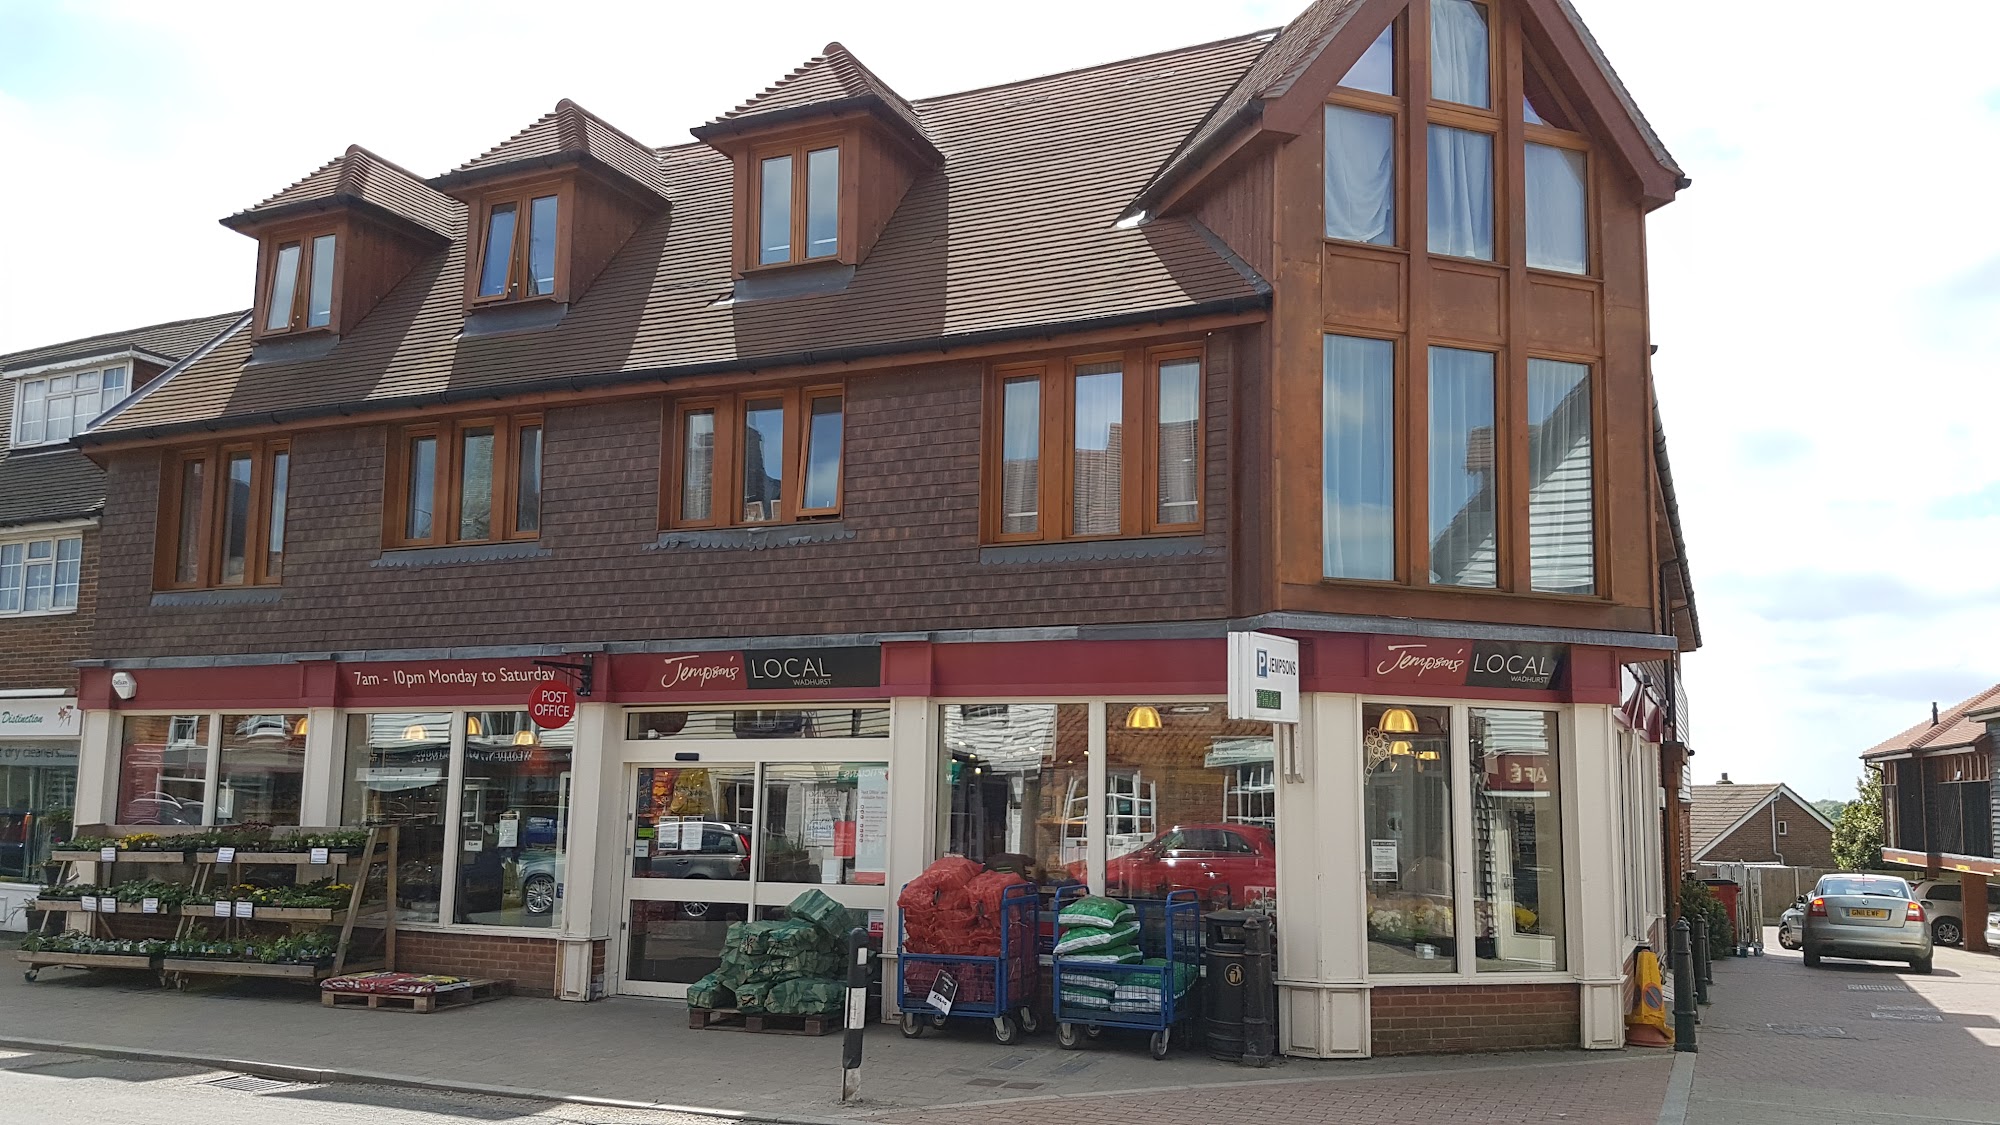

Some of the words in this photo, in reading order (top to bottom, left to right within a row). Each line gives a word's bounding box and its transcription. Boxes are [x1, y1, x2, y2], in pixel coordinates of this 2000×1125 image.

[751, 657, 832, 679] LOCAL
[1268, 657, 1296, 676] JEMPSONS
[1473, 653, 1549, 676] LOCAL
[353, 671, 380, 686] 7am
[393, 670, 426, 688] 10pm
[428, 668, 477, 687] Monday
[481, 671, 496, 683] to
[499, 666, 555, 682] Saturday
[793, 678, 832, 686] WADHURST
[1511, 675, 1548, 684] WADHURST
[541, 690, 567, 704] POST
[2, 711, 43, 724] Distinction
[534, 703, 570, 718] OFFICE
